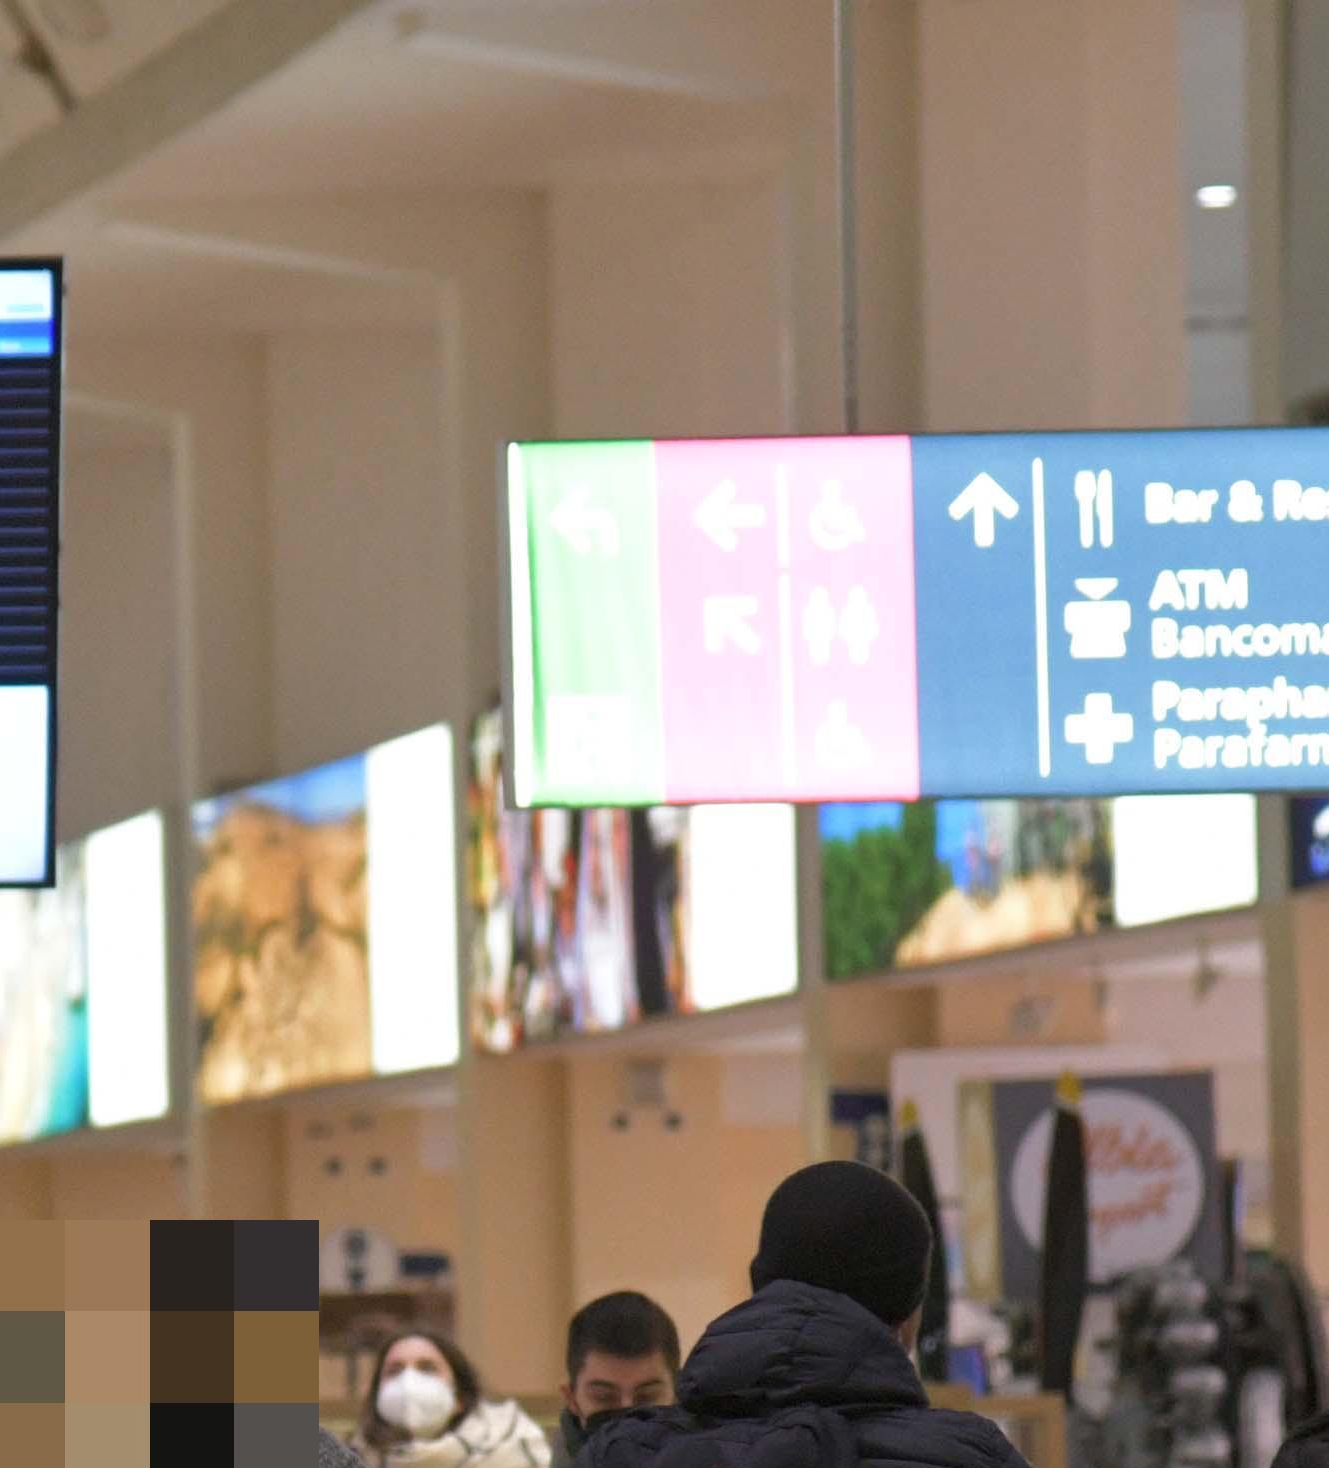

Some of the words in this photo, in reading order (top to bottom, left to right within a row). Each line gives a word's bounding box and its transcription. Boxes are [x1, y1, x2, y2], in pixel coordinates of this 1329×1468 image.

[1144, 481, 1218, 524] Bar
[1228, 480, 1263, 522] &
[1148, 568, 1249, 610] ATM
